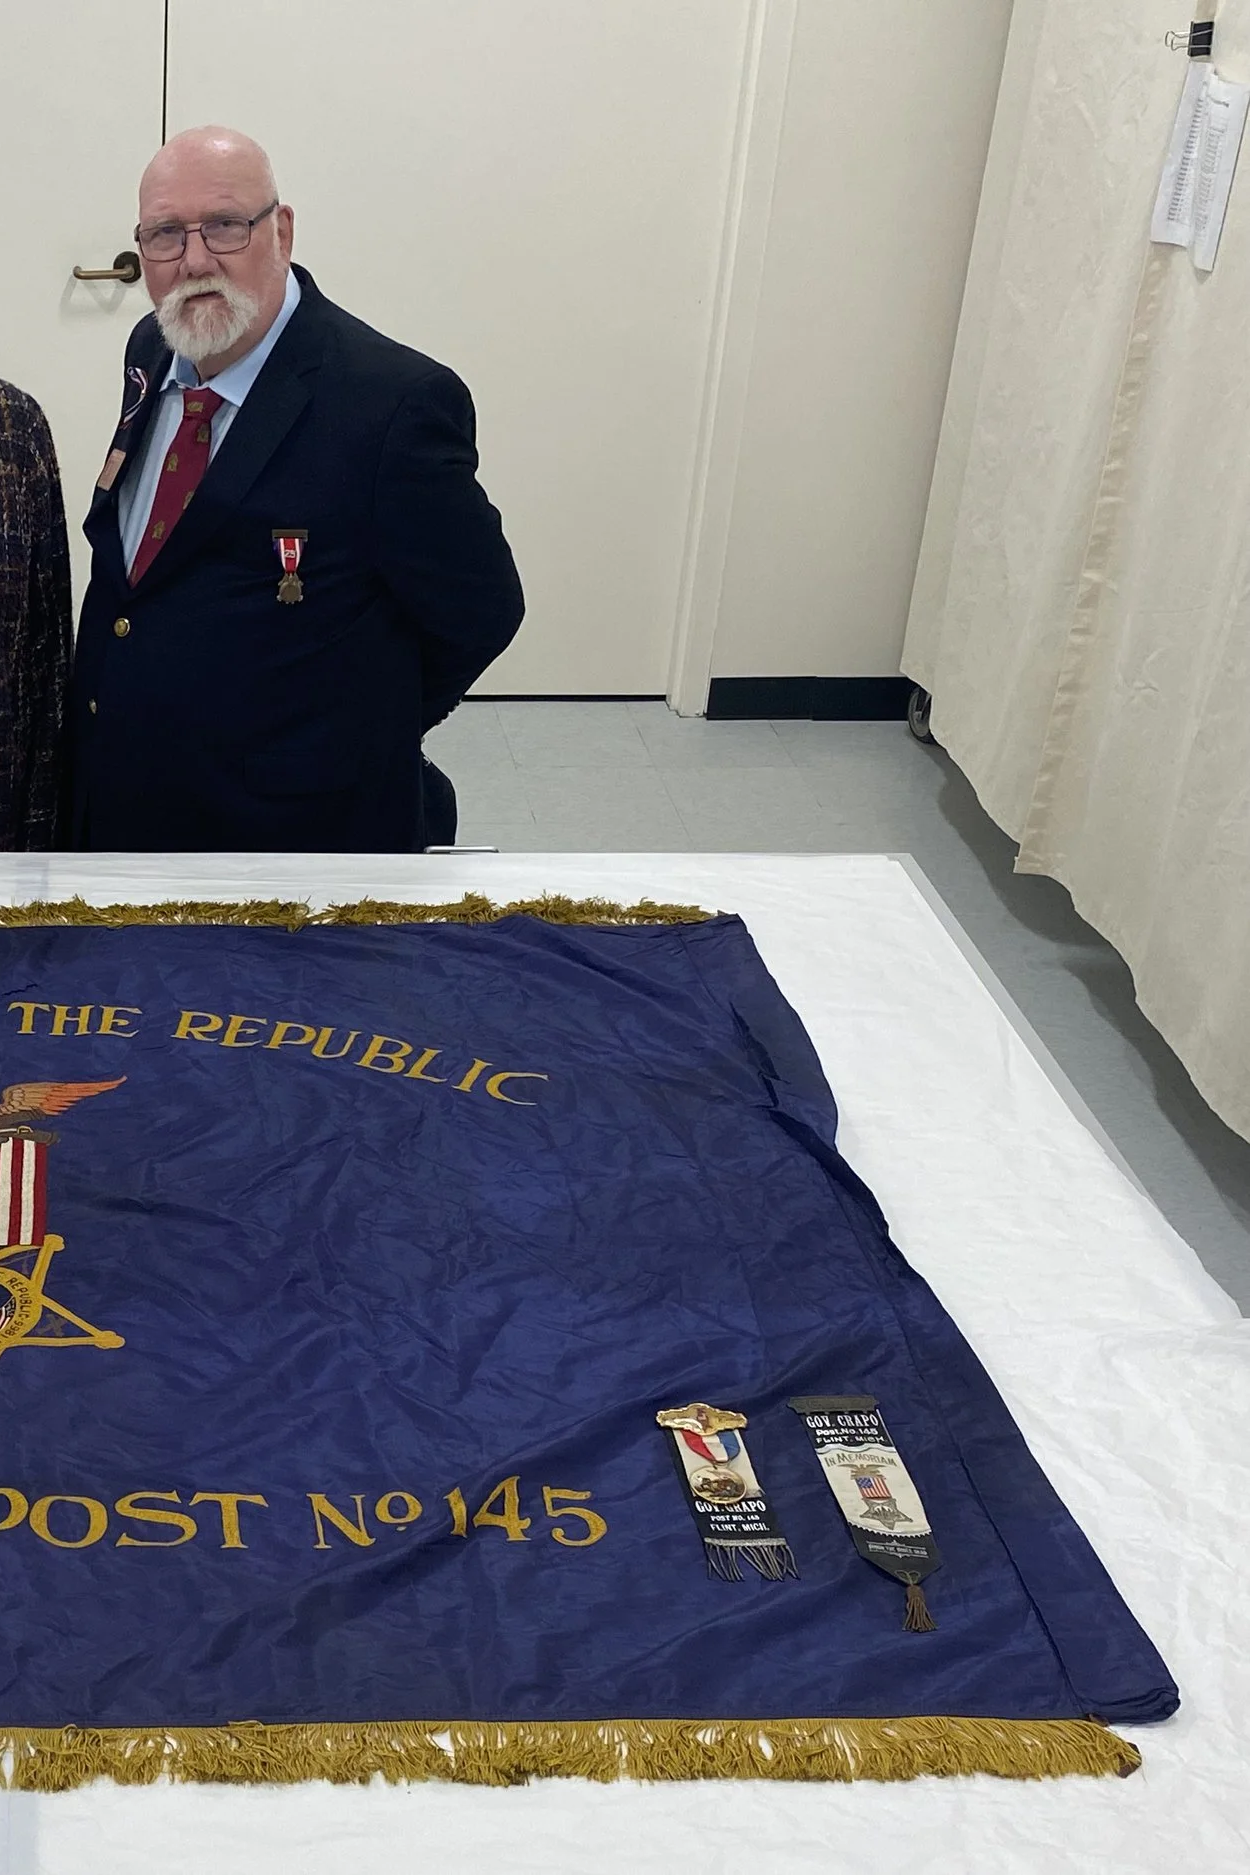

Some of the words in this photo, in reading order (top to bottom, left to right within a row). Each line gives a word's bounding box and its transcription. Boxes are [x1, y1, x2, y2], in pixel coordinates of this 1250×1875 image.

[7, 1001, 143, 1038] THE
[171, 1010, 549, 1106] REPUBLIC
[806, 1415, 836, 1428] GOV.
[837, 1413, 879, 1427] CRAPO
[443, 1475, 608, 1547] 145
